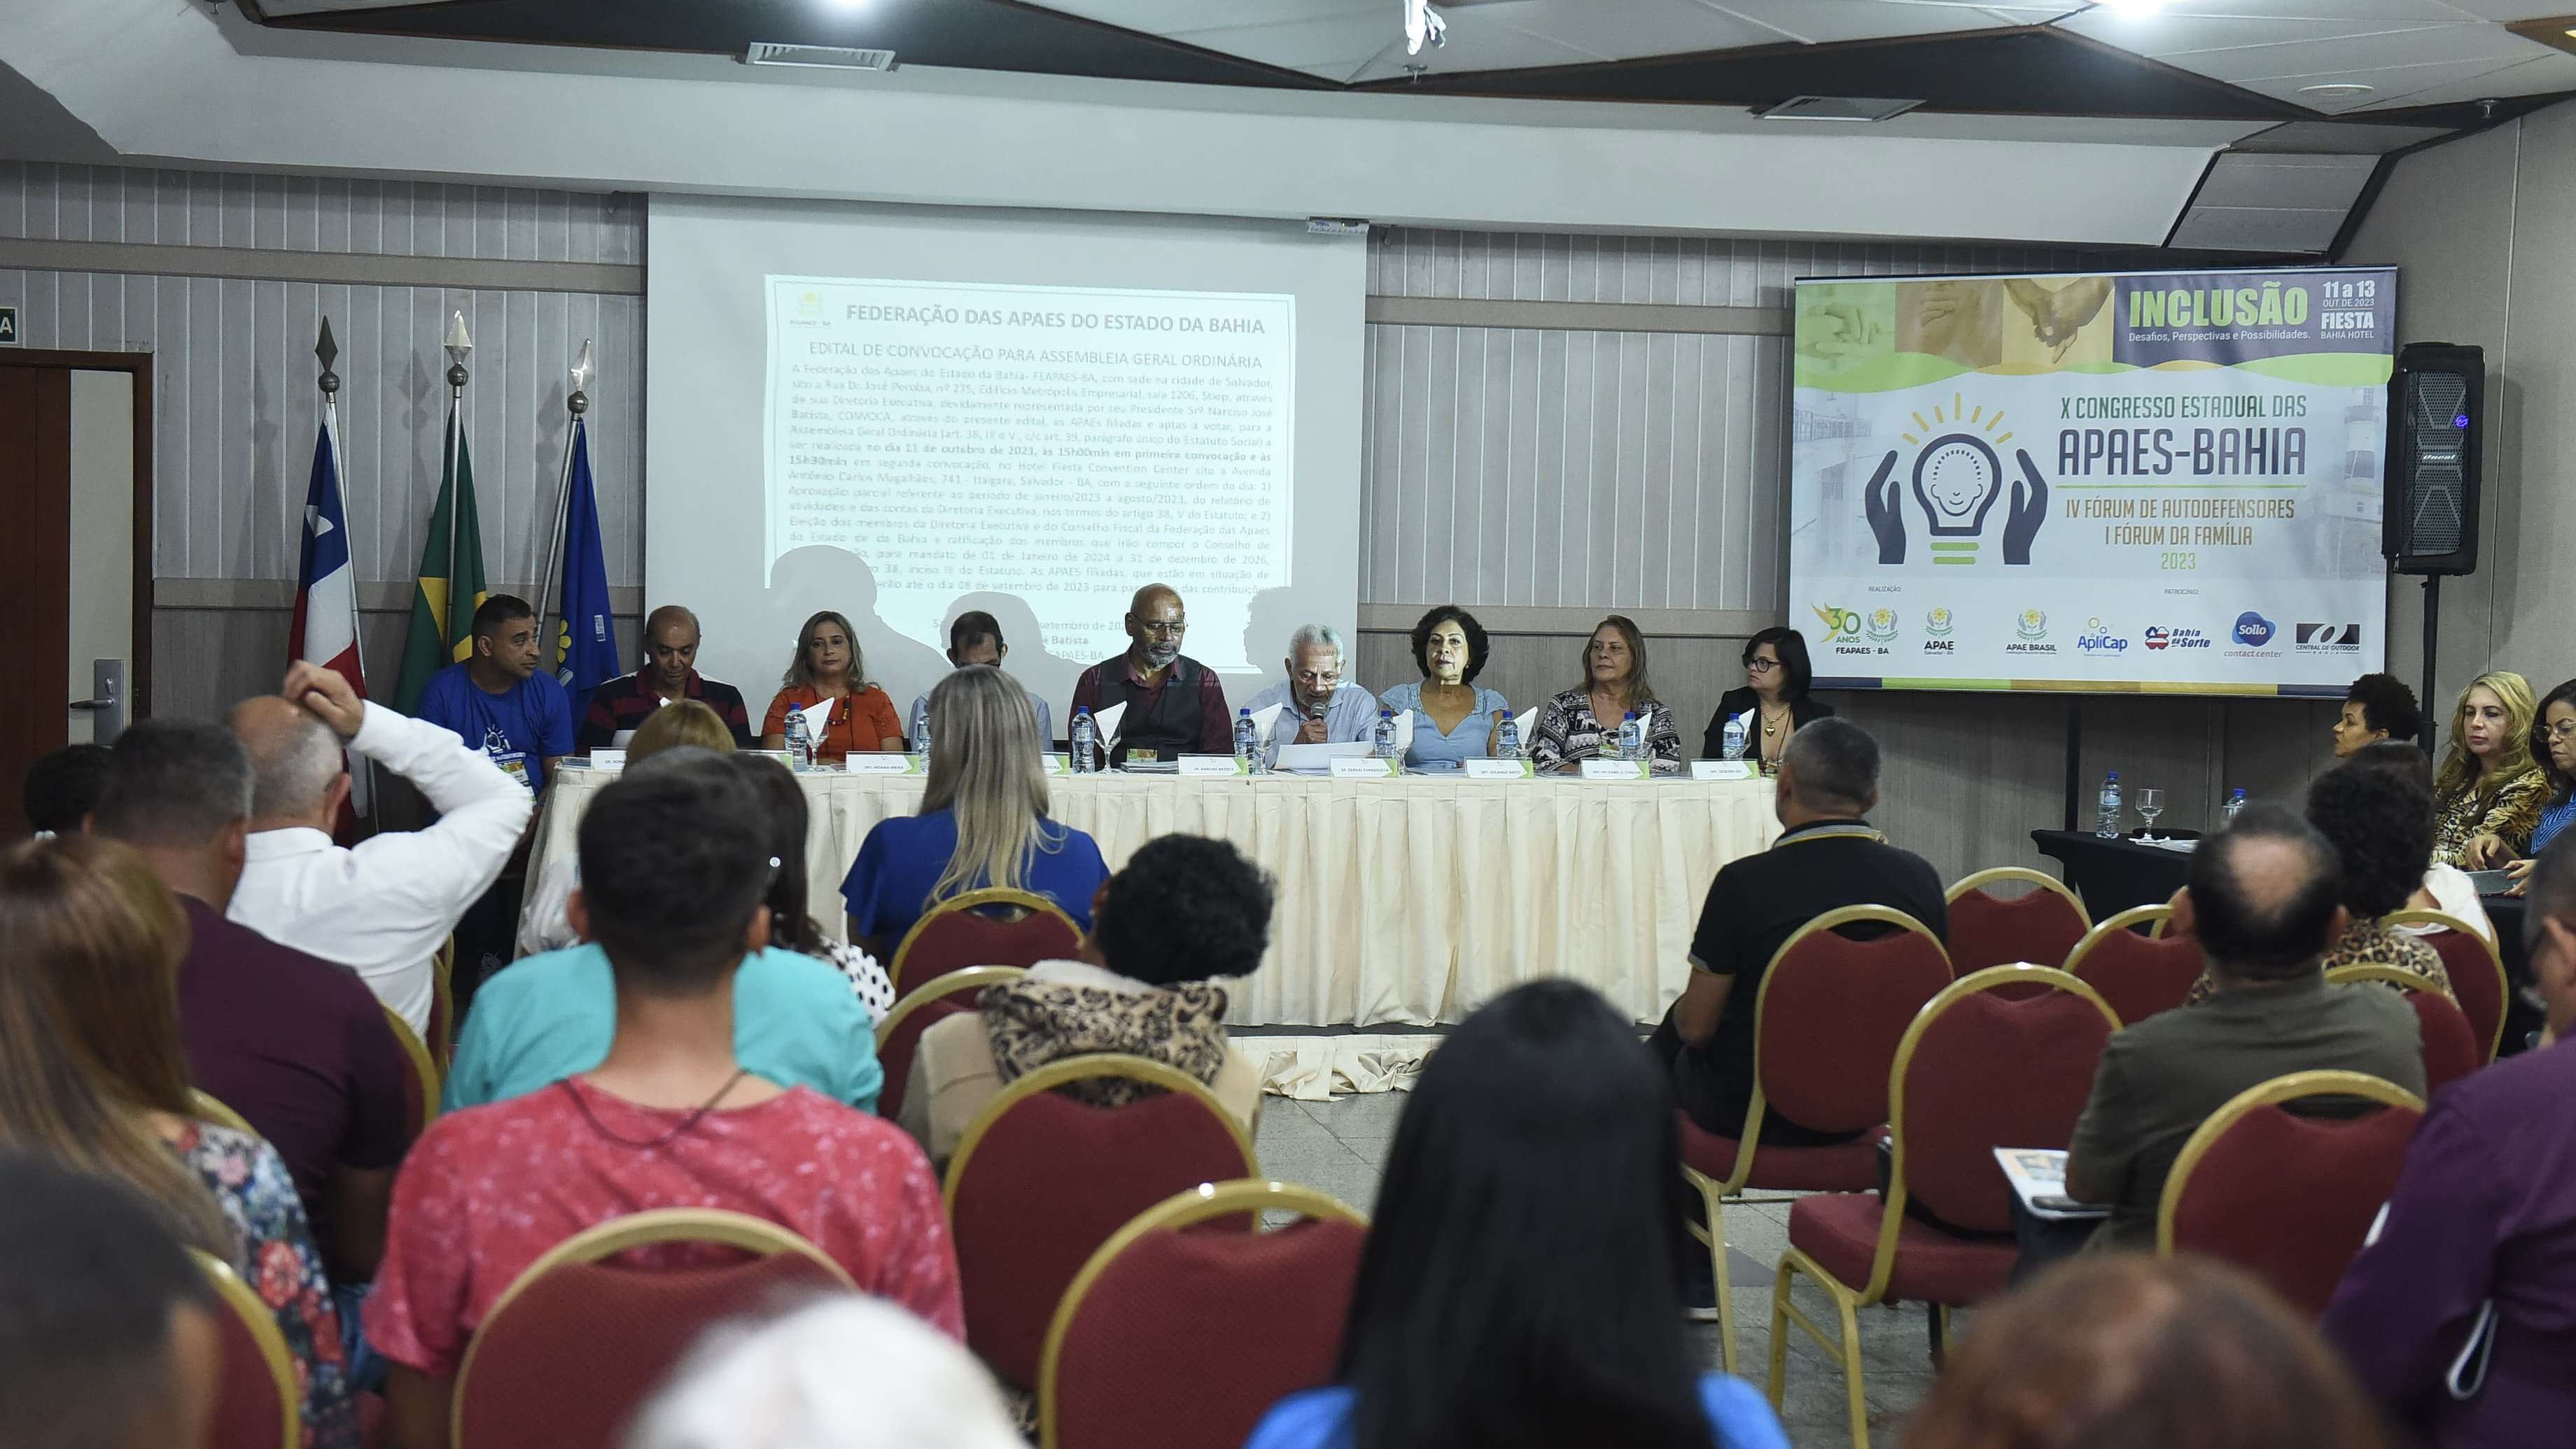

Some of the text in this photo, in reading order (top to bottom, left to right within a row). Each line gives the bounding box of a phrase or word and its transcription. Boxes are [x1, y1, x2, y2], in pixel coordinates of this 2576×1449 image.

[2323, 280, 2375, 298] 11 a 13
[2129, 281, 2308, 328] INCLUSÃO
[2323, 299, 2340, 307] OUT
[2355, 298, 2374, 307] 2023
[846, 302, 1265, 334] FEDERAÇÃO DAS APAES DO ESTADO DA BAHIA
[2321, 312, 2374, 330] FIESTA
[2129, 332, 2171, 342] Desafios,
[2173, 331, 2231, 343] Perspectivas
[2241, 330, 2311, 340] Possibilidades.
[2320, 331, 2346, 340] BAHIA
[809, 342, 1261, 369] EDITAL DE CONVOCAÇÃO PARA ASSEMBLEIA GERAL ORDINÁRIA
[1170, 376, 1204, 385] cidade
[1225, 378, 1273, 389] Salvador,
[2061, 395, 2307, 419] X CONGRESSO ESTADUAL DAS
[1238, 425, 1260, 433] para
[1135, 449, 1180, 461] primeira
[1185, 451, 1246, 462] convocação
[2058, 427, 2306, 476] APAES-BAHIA
[2066, 496, 2295, 519] IV FÓRUM DE AUTODEFENSORES
[2105, 522, 2253, 546] I FÓRUM DA FAMÍLIA
[2161, 552, 2196, 570] 2023
[1829, 608, 1861, 634] 30
[2172, 628, 2201, 637] Bahia
[2238, 624, 2267, 635] Sollo
[1052, 636, 1088, 645] Batista
[1924, 640, 1954, 650] APAE
[2180, 638, 2211, 648] Sorte
[2224, 650, 2255, 658] contact
